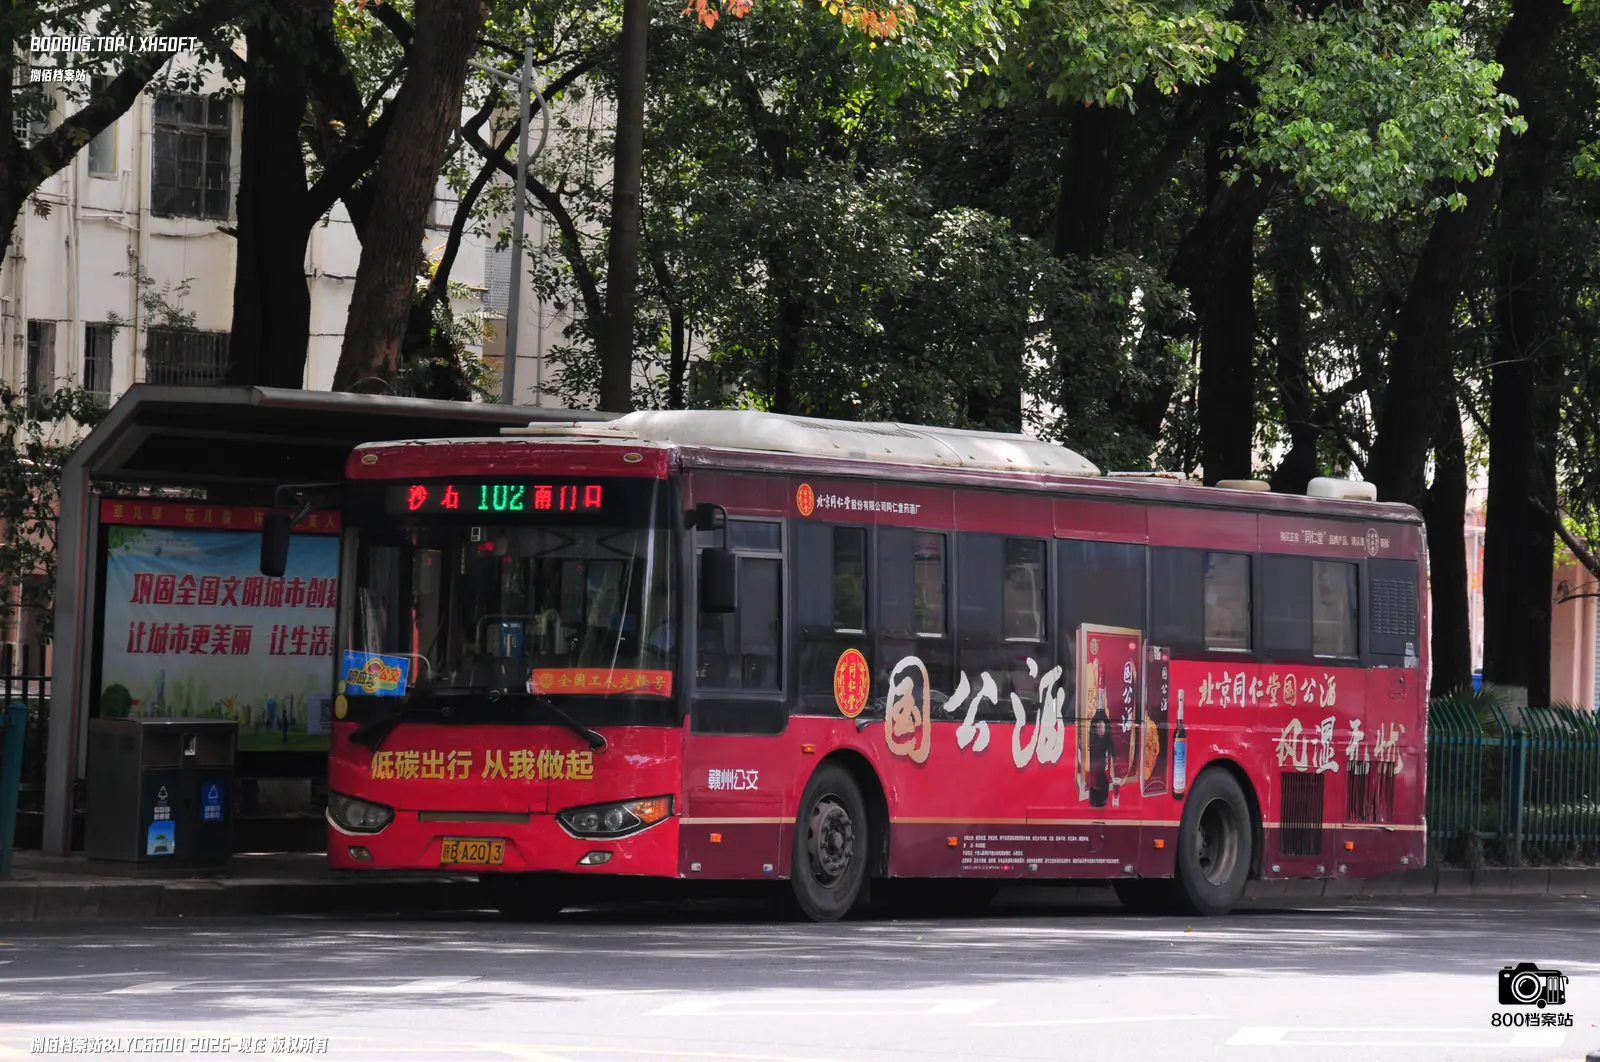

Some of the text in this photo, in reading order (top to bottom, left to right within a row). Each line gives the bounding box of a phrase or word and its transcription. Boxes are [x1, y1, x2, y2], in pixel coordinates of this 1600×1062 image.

[478, 485, 524, 510] 102
[127, 621, 252, 656] 让城市更美丽
[557, 673, 666, 691] 全国工人先锋号
[370, 750, 594, 781] 低碳出行 从我做起
[708, 768, 759, 791] 赣州公交
